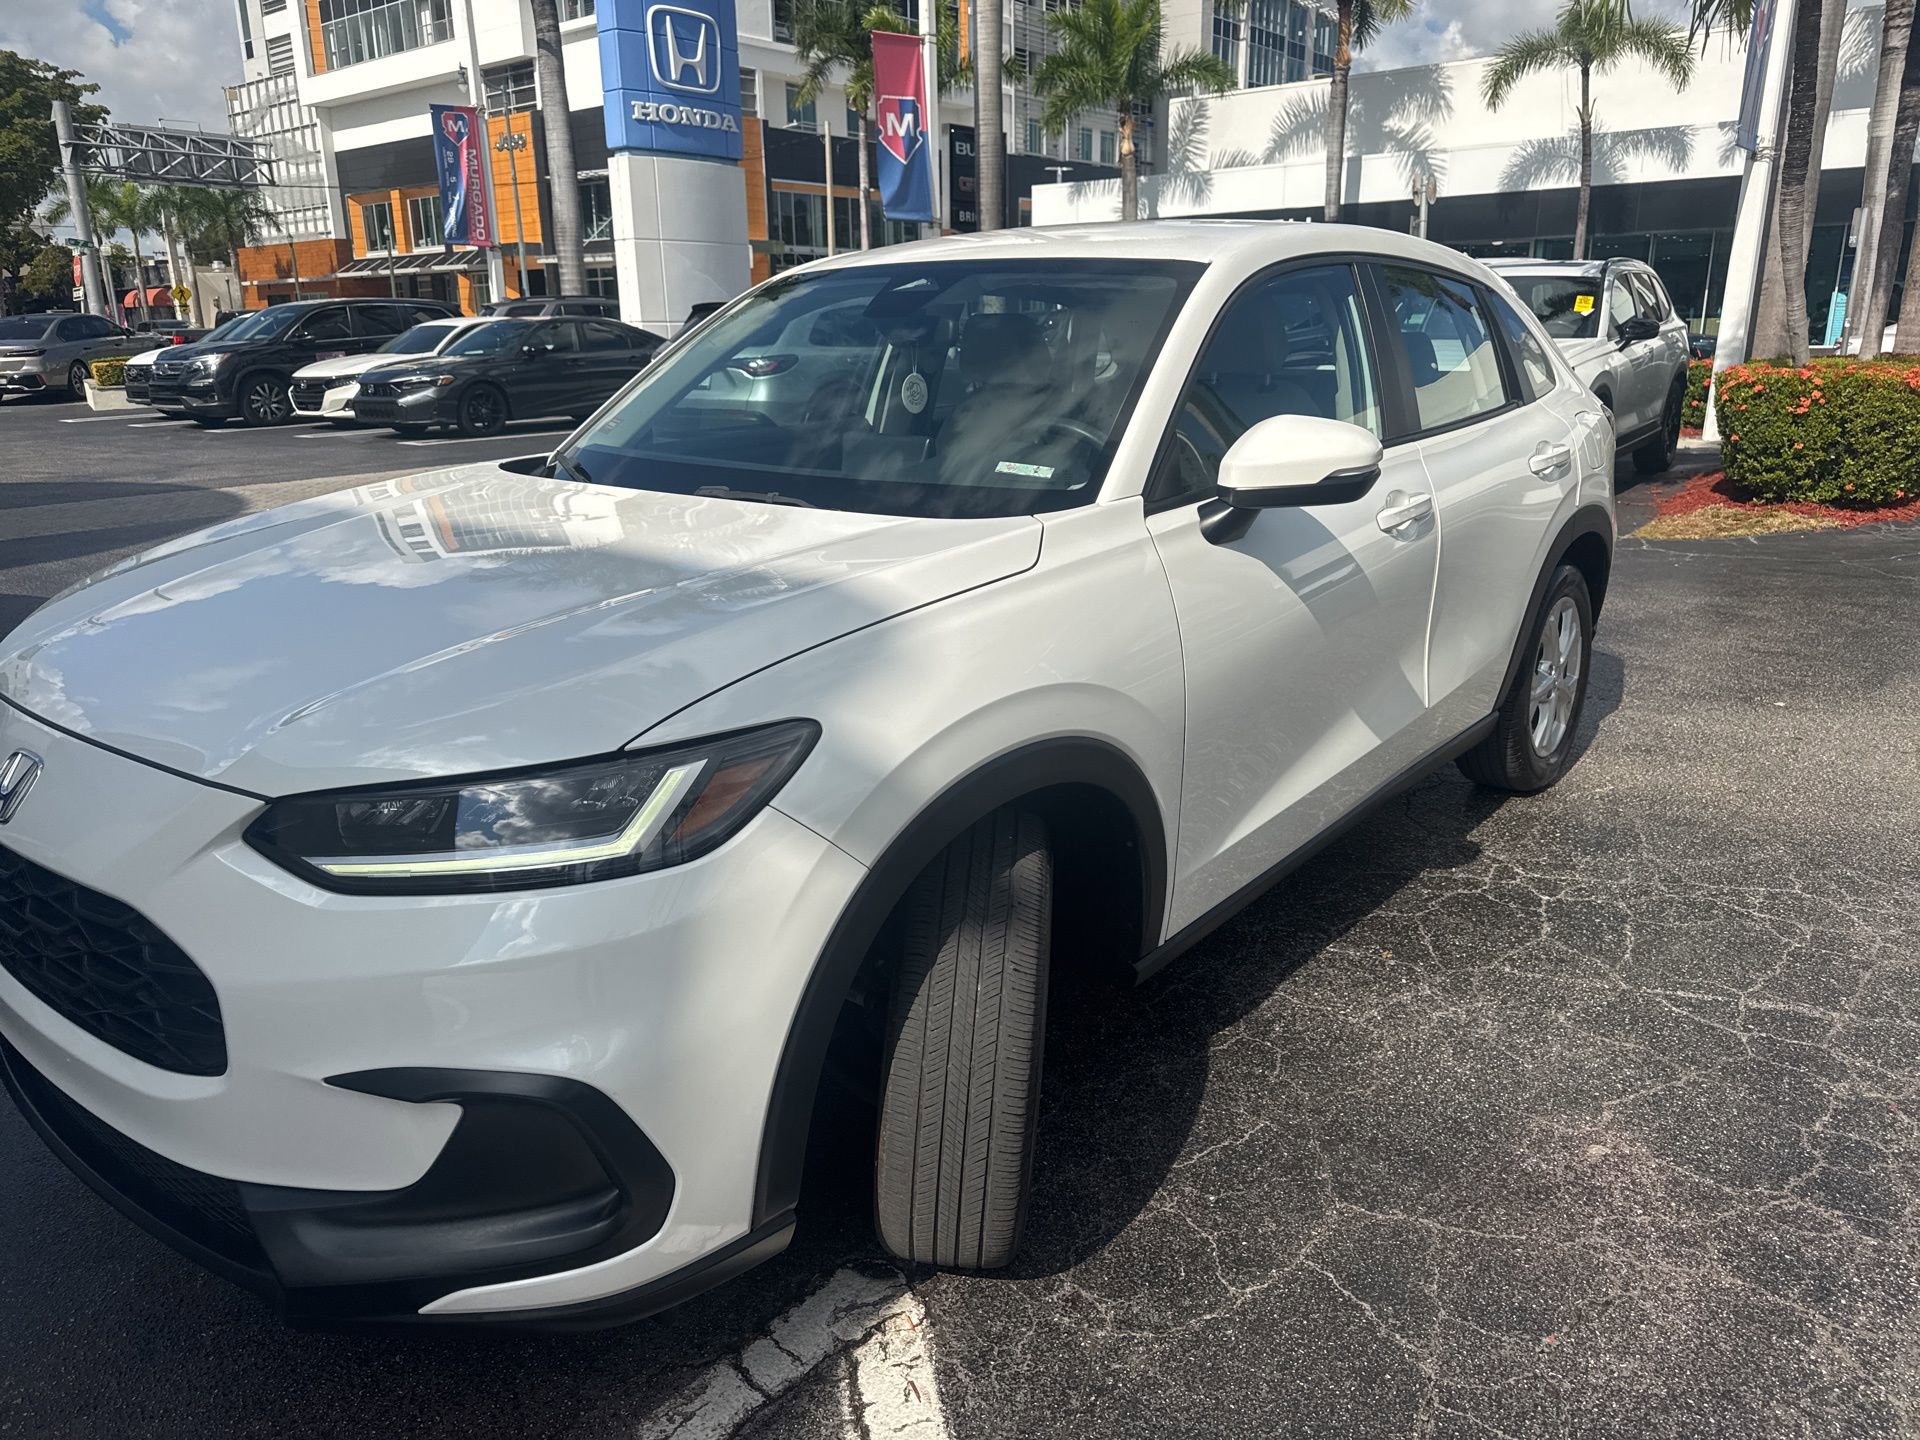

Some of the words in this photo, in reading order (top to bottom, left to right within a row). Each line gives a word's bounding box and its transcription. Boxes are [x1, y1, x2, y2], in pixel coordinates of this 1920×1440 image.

[447, 119, 464, 133] M
[631, 100, 739, 133] HONDA
[887, 112, 914, 138] M
[955, 141, 976, 157] BU
[468, 149, 486, 240] MURGADO
[959, 210, 976, 223] BRI
